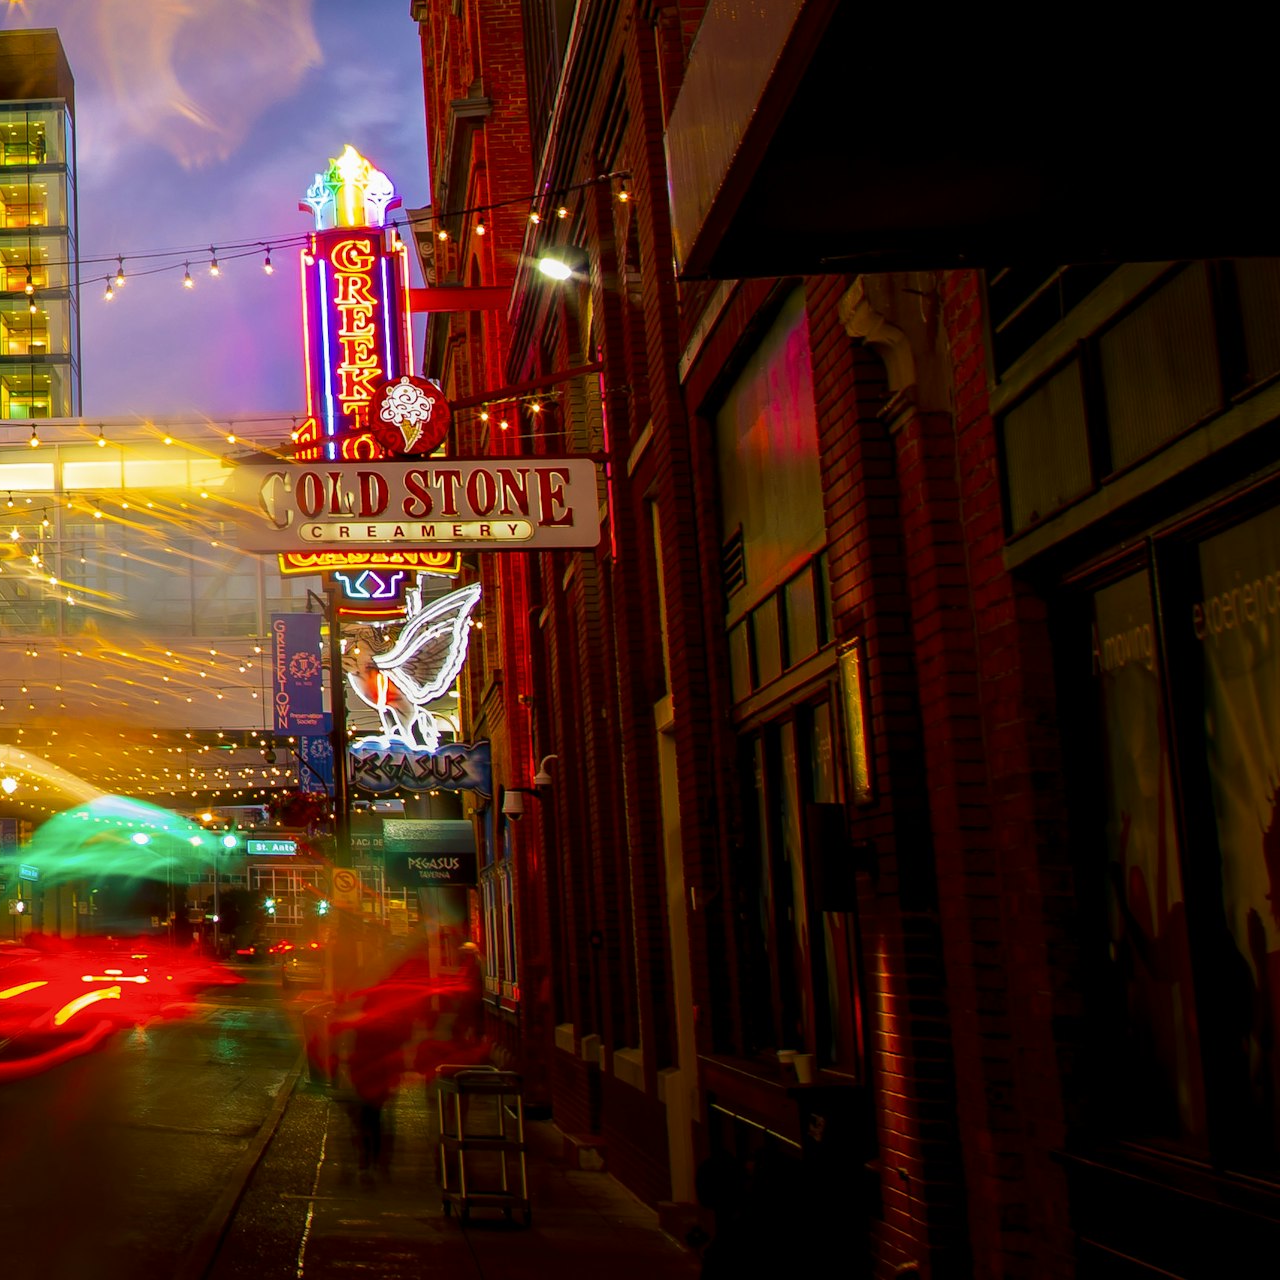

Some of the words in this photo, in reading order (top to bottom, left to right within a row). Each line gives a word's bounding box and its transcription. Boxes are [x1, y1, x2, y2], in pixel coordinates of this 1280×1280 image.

[330, 239, 383, 460] GREEKTO
[259, 470, 389, 530] COLD
[401, 467, 575, 527] STONE
[311, 524, 519, 539] CREAMERY
[273, 619, 289, 730] GREEKTOWN
[349, 751, 468, 785] PEGASUS
[407, 857, 460, 870] PEGASUS
[418, 870, 450, 880] TAVERNA
